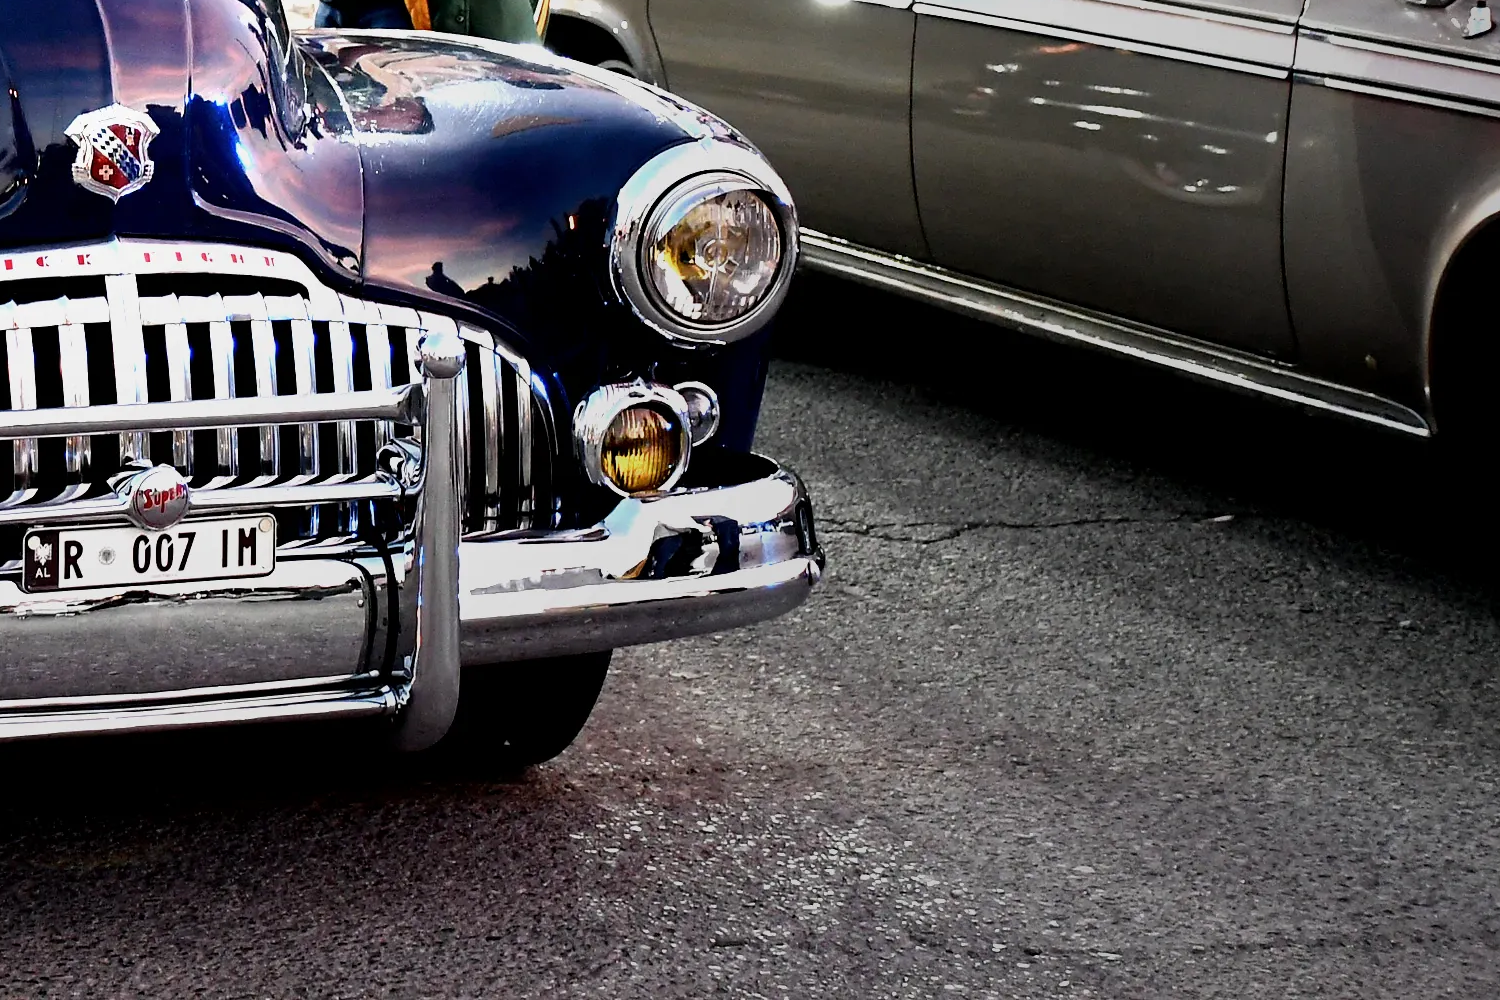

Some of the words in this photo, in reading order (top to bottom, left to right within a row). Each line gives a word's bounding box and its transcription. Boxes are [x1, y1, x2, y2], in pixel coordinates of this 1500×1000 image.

[63, 540, 84, 580] R
[132, 531, 197, 574] 007
[221, 526, 257, 568] IM
[34, 567, 51, 579] AL
